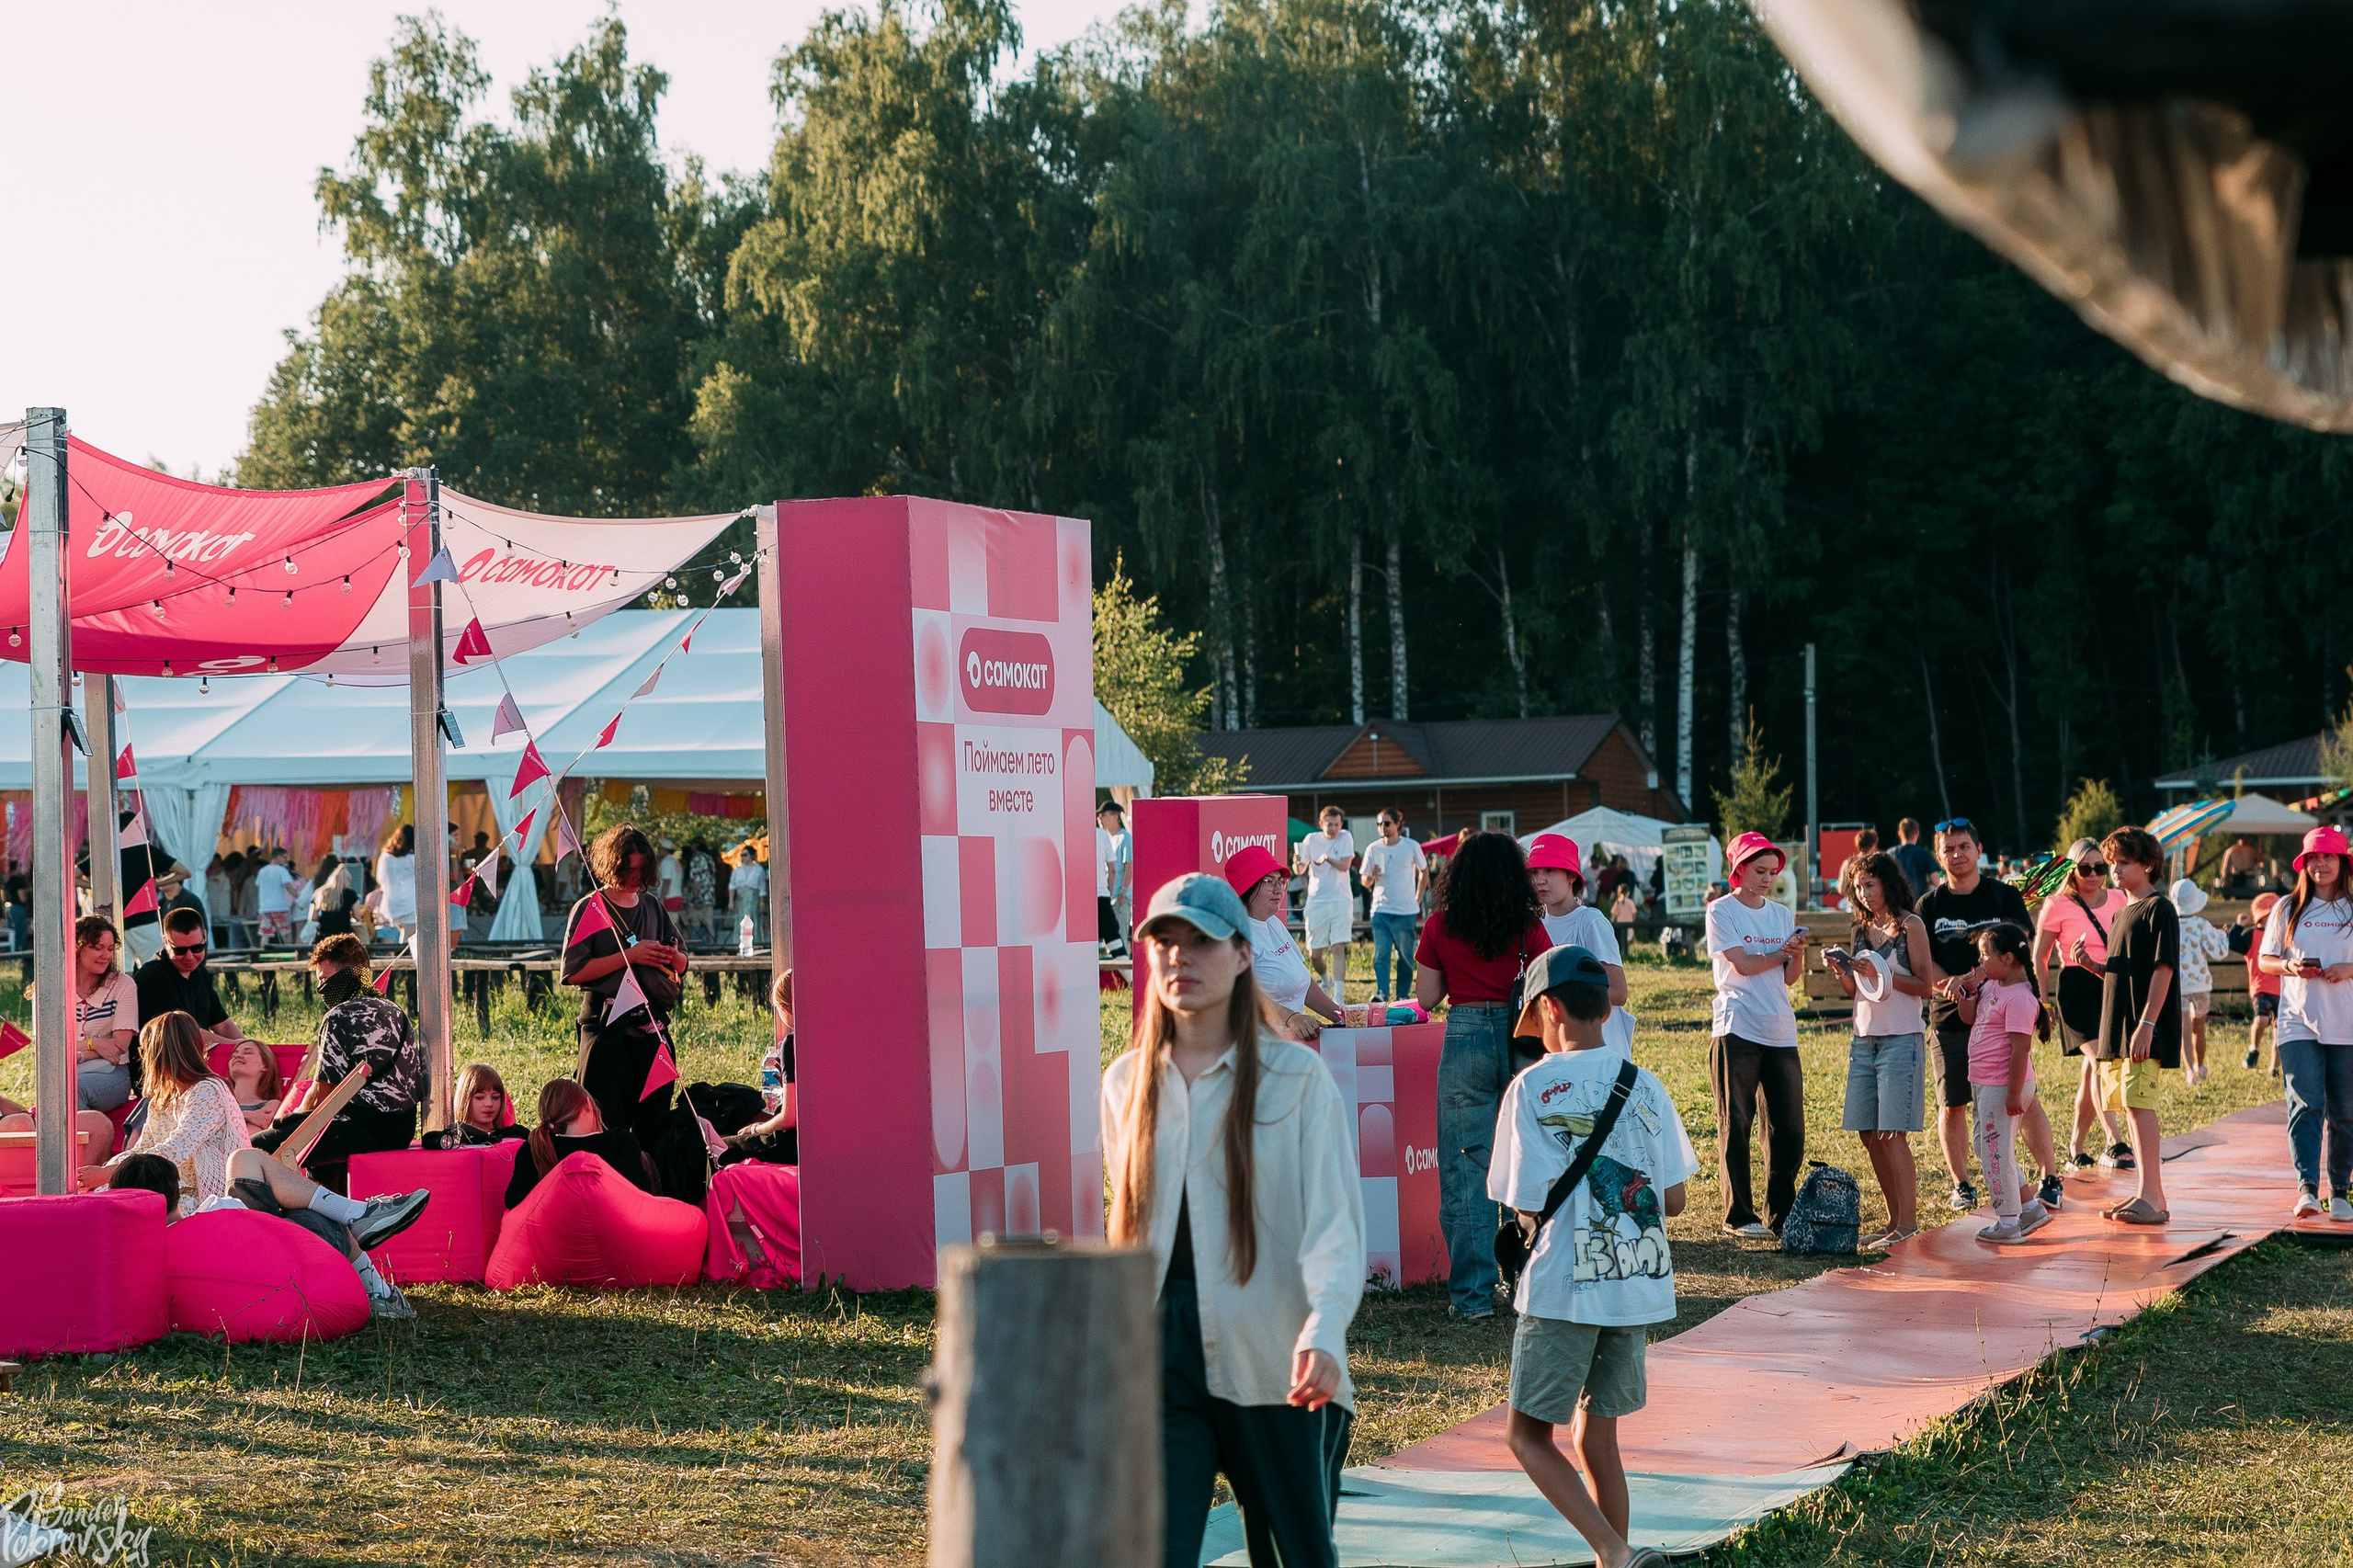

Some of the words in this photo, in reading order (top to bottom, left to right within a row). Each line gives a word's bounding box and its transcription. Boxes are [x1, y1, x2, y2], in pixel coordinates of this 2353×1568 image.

[114, 527, 256, 562] самокат
[480, 558, 616, 591] самокат
[984, 659, 1048, 689] самокат
[963, 740, 1024, 773] Поймаем
[1027, 752, 1055, 774] лето
[989, 790, 1034, 812] вместе
